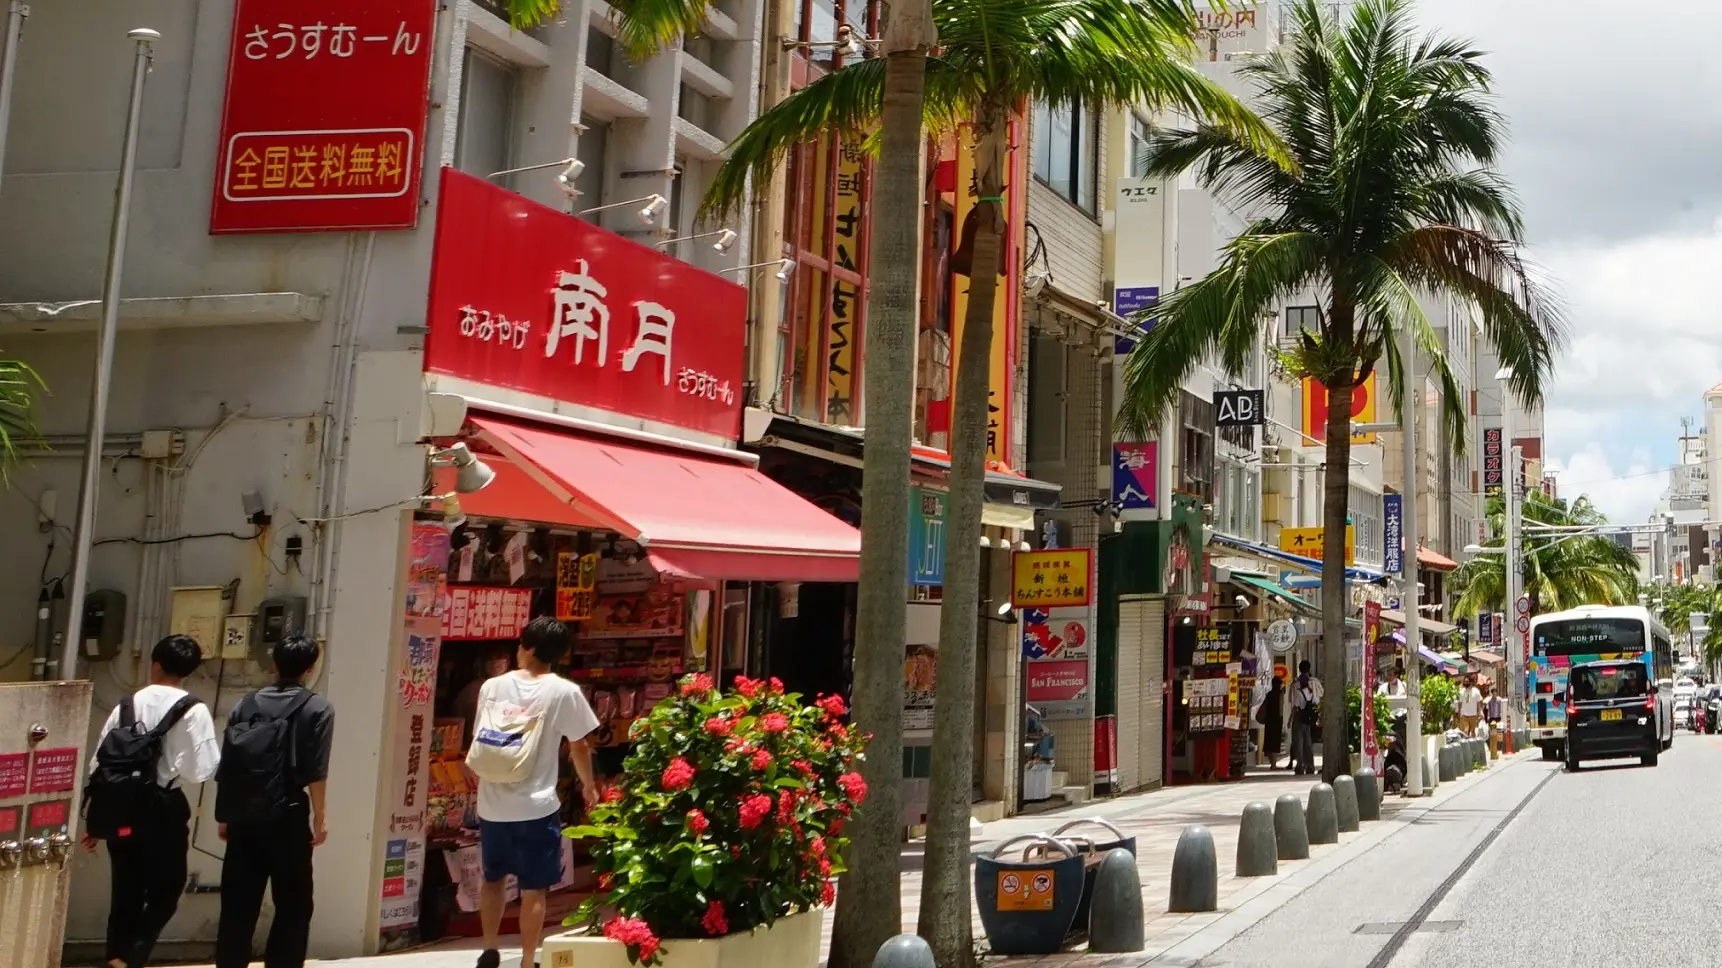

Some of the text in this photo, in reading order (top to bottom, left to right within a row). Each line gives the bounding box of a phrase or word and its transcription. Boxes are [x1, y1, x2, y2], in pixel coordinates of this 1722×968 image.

[244, 20, 421, 60] さうすむーん
[232, 141, 403, 191] 全国送料無料
[458, 257, 734, 406] おみやげ 南月 さうすむーん
[1486, 429, 1501, 483] カラオケ
